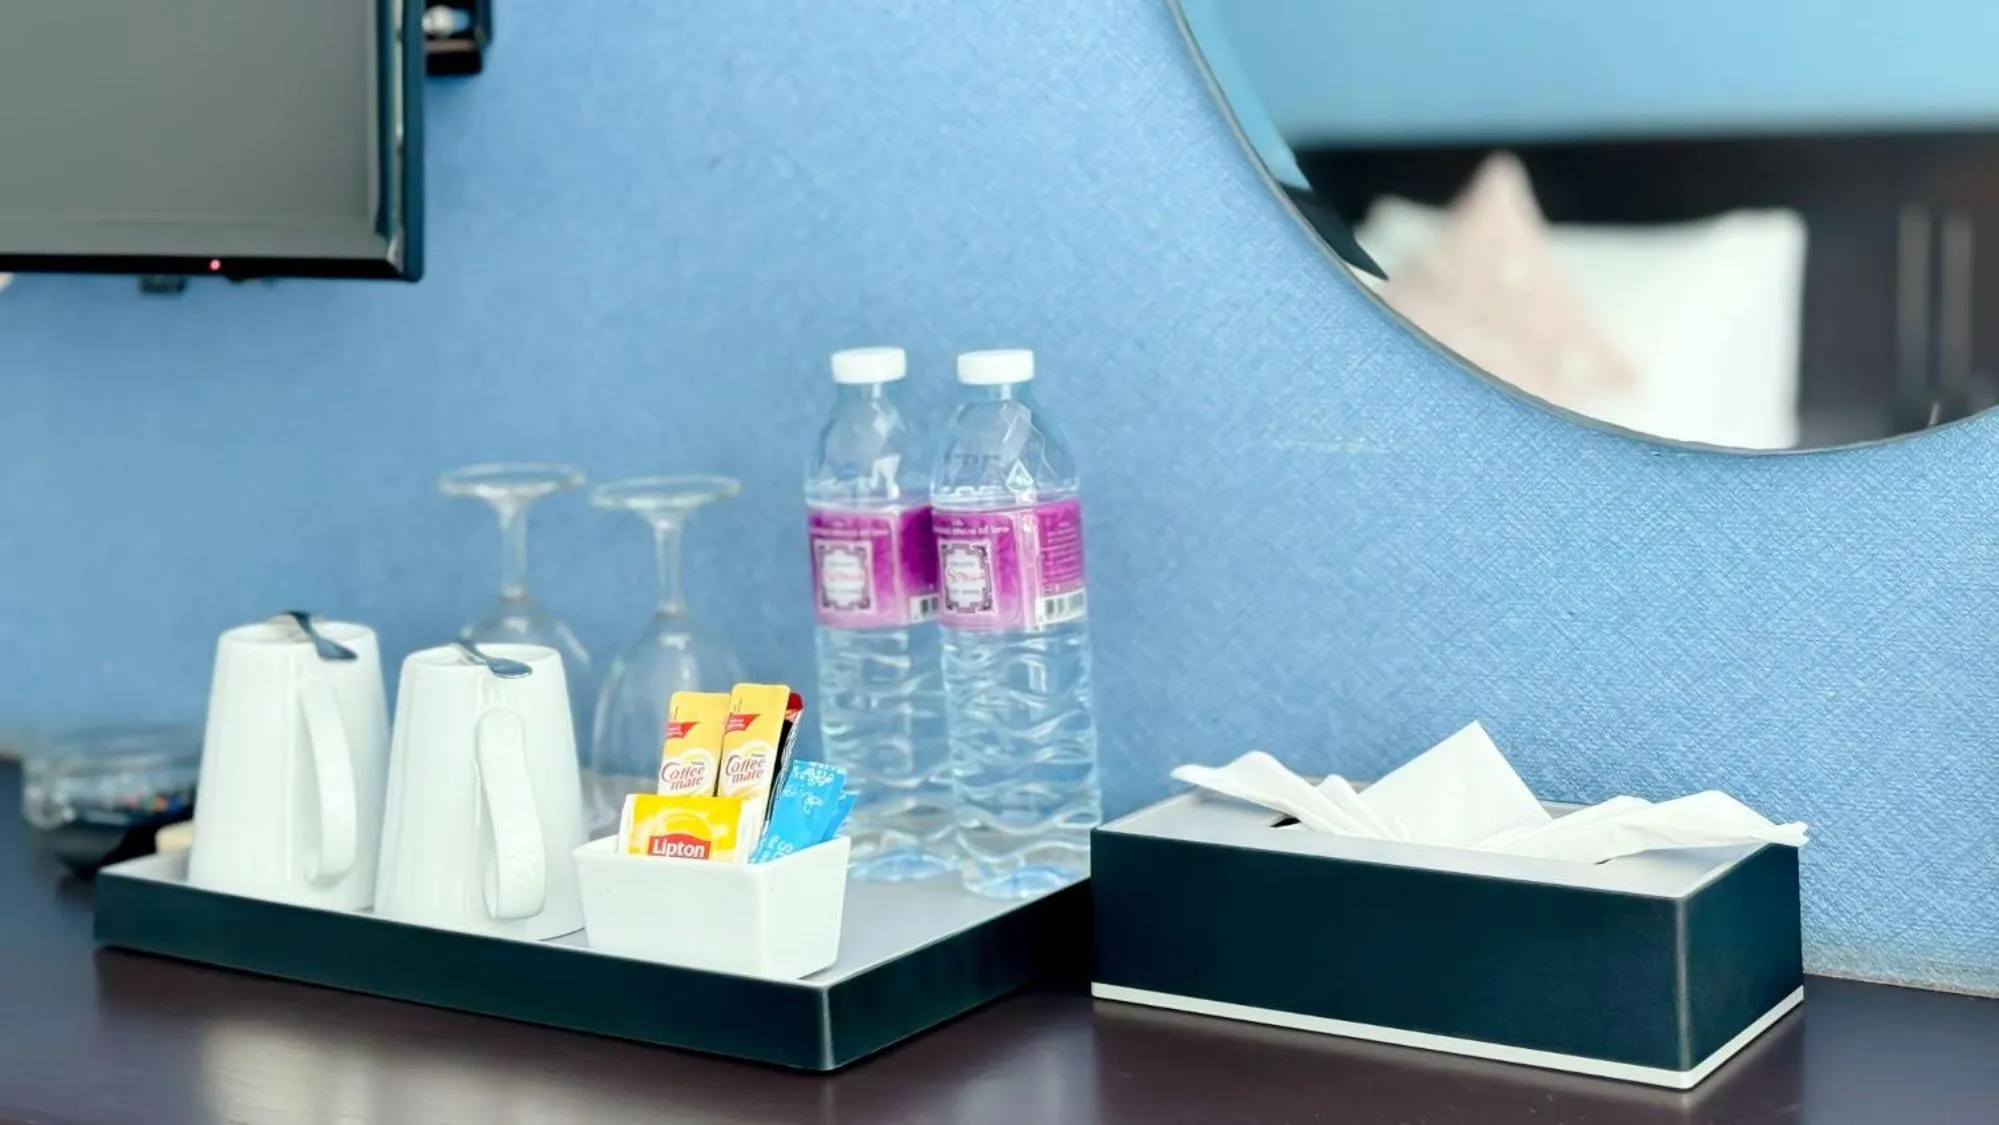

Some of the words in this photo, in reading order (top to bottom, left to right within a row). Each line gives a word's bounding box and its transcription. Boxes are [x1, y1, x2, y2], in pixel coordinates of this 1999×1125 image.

[661, 761, 705, 783] Coffee
[725, 755, 766, 777] Coffee
[670, 776, 704, 790] mate
[732, 769, 765, 784] mate
[652, 839, 705, 858] Lipton
